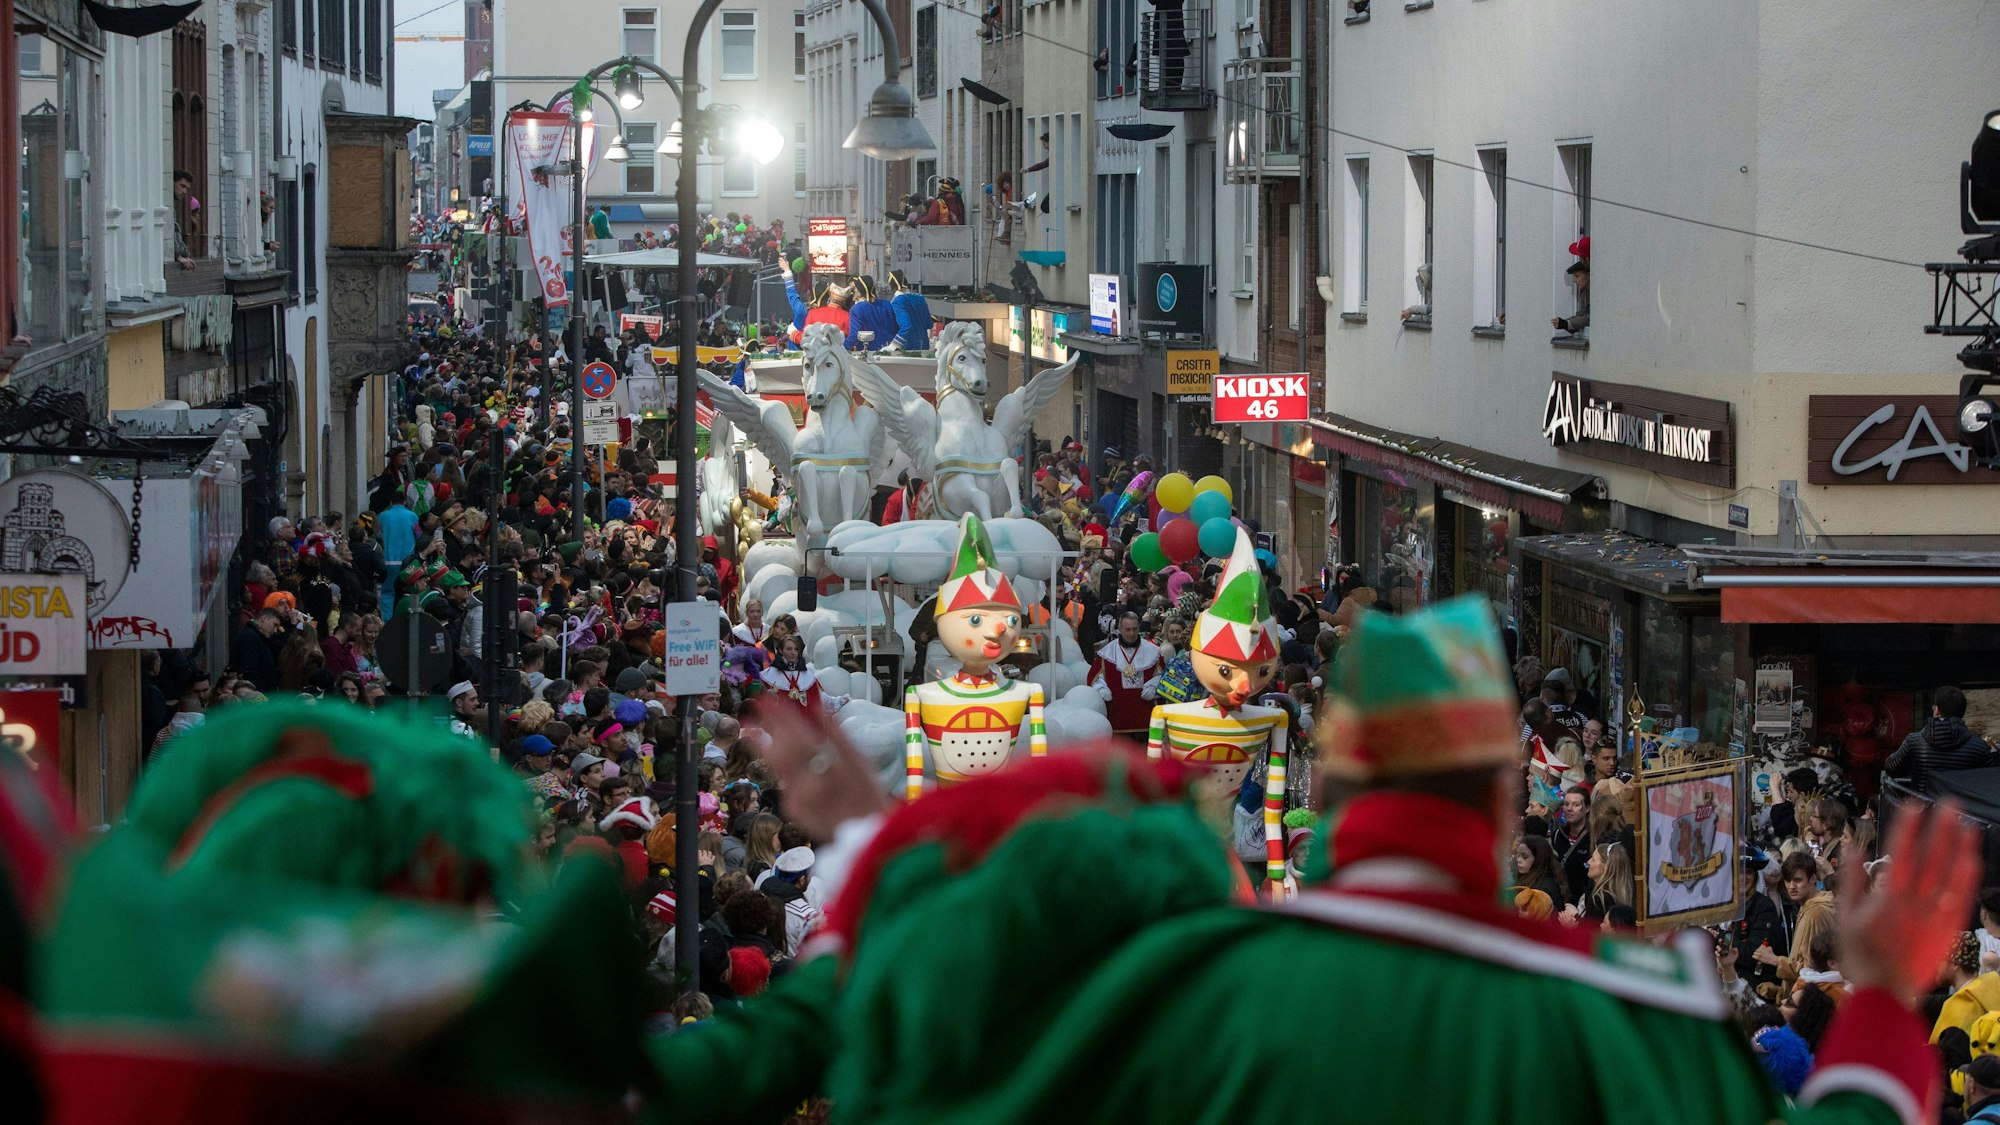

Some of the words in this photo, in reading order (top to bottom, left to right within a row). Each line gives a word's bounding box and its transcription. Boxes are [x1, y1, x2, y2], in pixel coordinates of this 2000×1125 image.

[1176, 359, 1211, 371] CASITA
[1170, 372, 1217, 385] MEXICAN
[1216, 377, 1307, 398] KIOSK
[1246, 399, 1279, 419] 46
[1656, 412, 1712, 463] FEINKOST
[0, 586, 73, 618] ISTA
[669, 642, 691, 653] Free
[695, 639, 717, 650] WiFi
[669, 656, 682, 667] für
[686, 655, 708, 666] alle!
